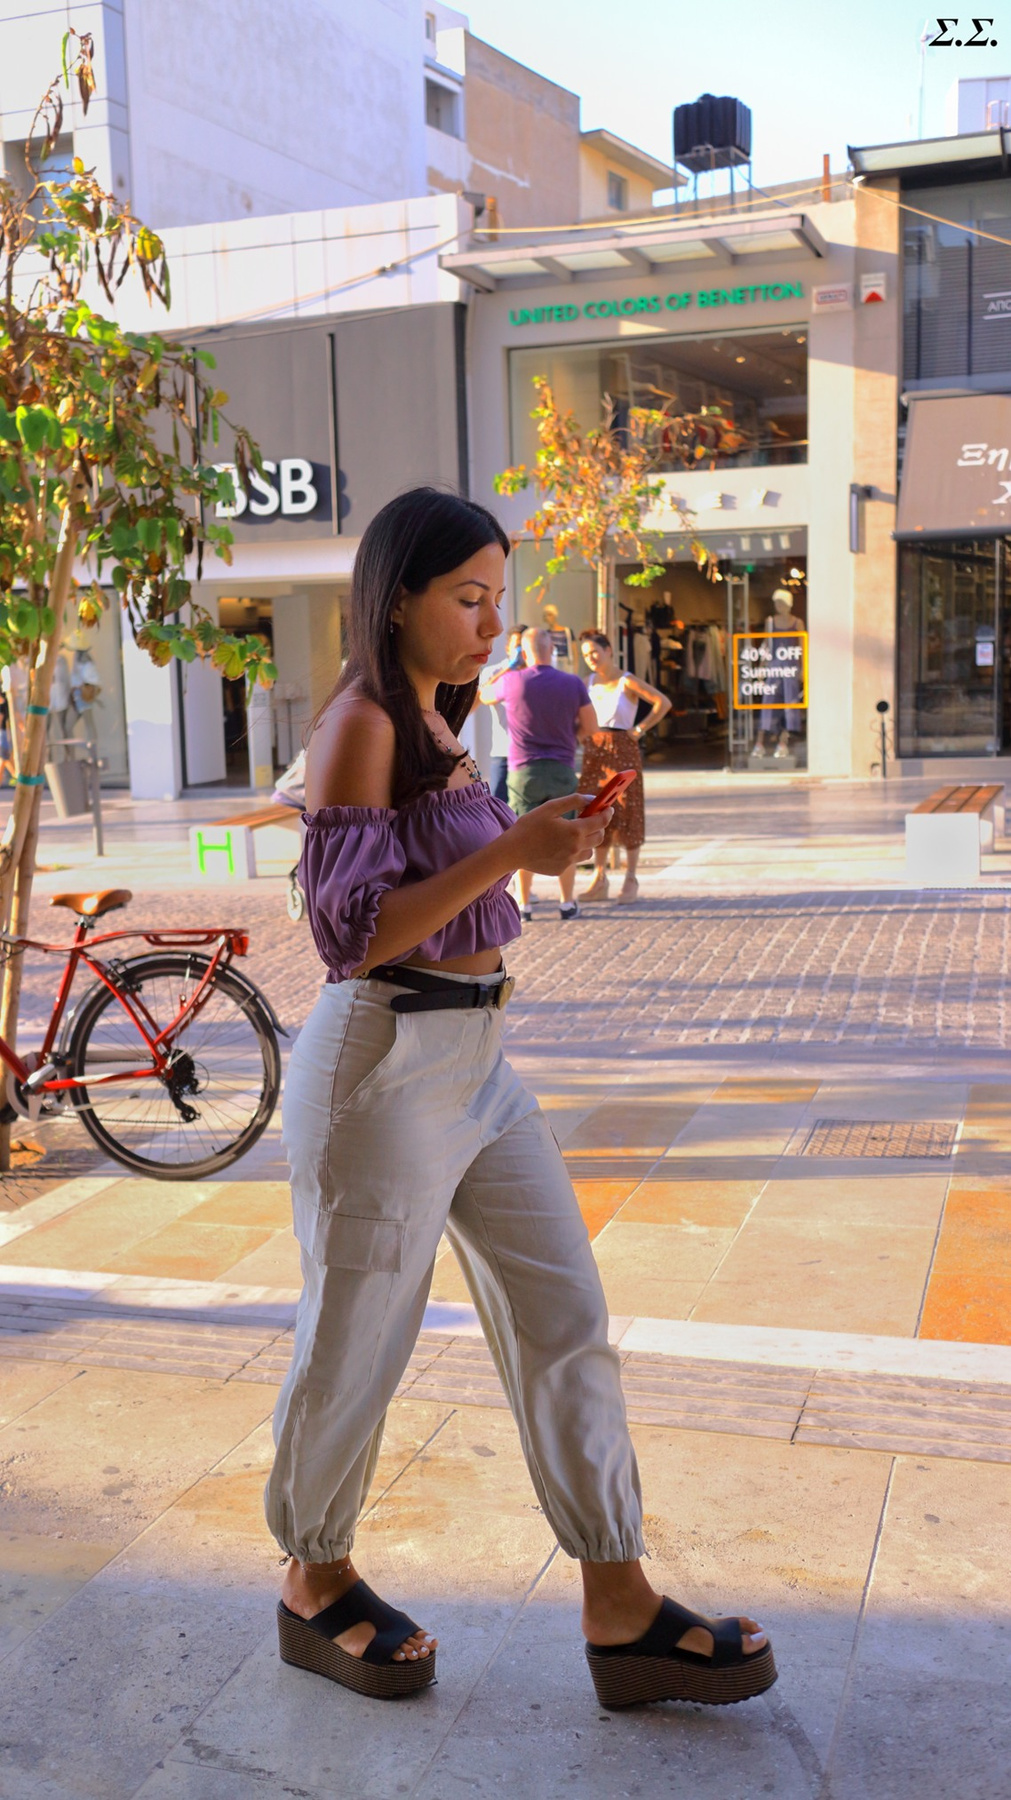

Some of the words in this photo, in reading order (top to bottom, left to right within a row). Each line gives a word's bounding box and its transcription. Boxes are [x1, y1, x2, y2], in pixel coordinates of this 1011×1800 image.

[508, 304, 579, 327] UNITED
[582, 295, 662, 320] COLORS
[664, 292, 692, 312] OF
[957, 443, 1011, 472] Ξη
[740, 647, 773, 662] 40%
[776, 646, 803, 661] OFF
[741, 664, 798, 679] Summer
[741, 681, 777, 696] Offer
